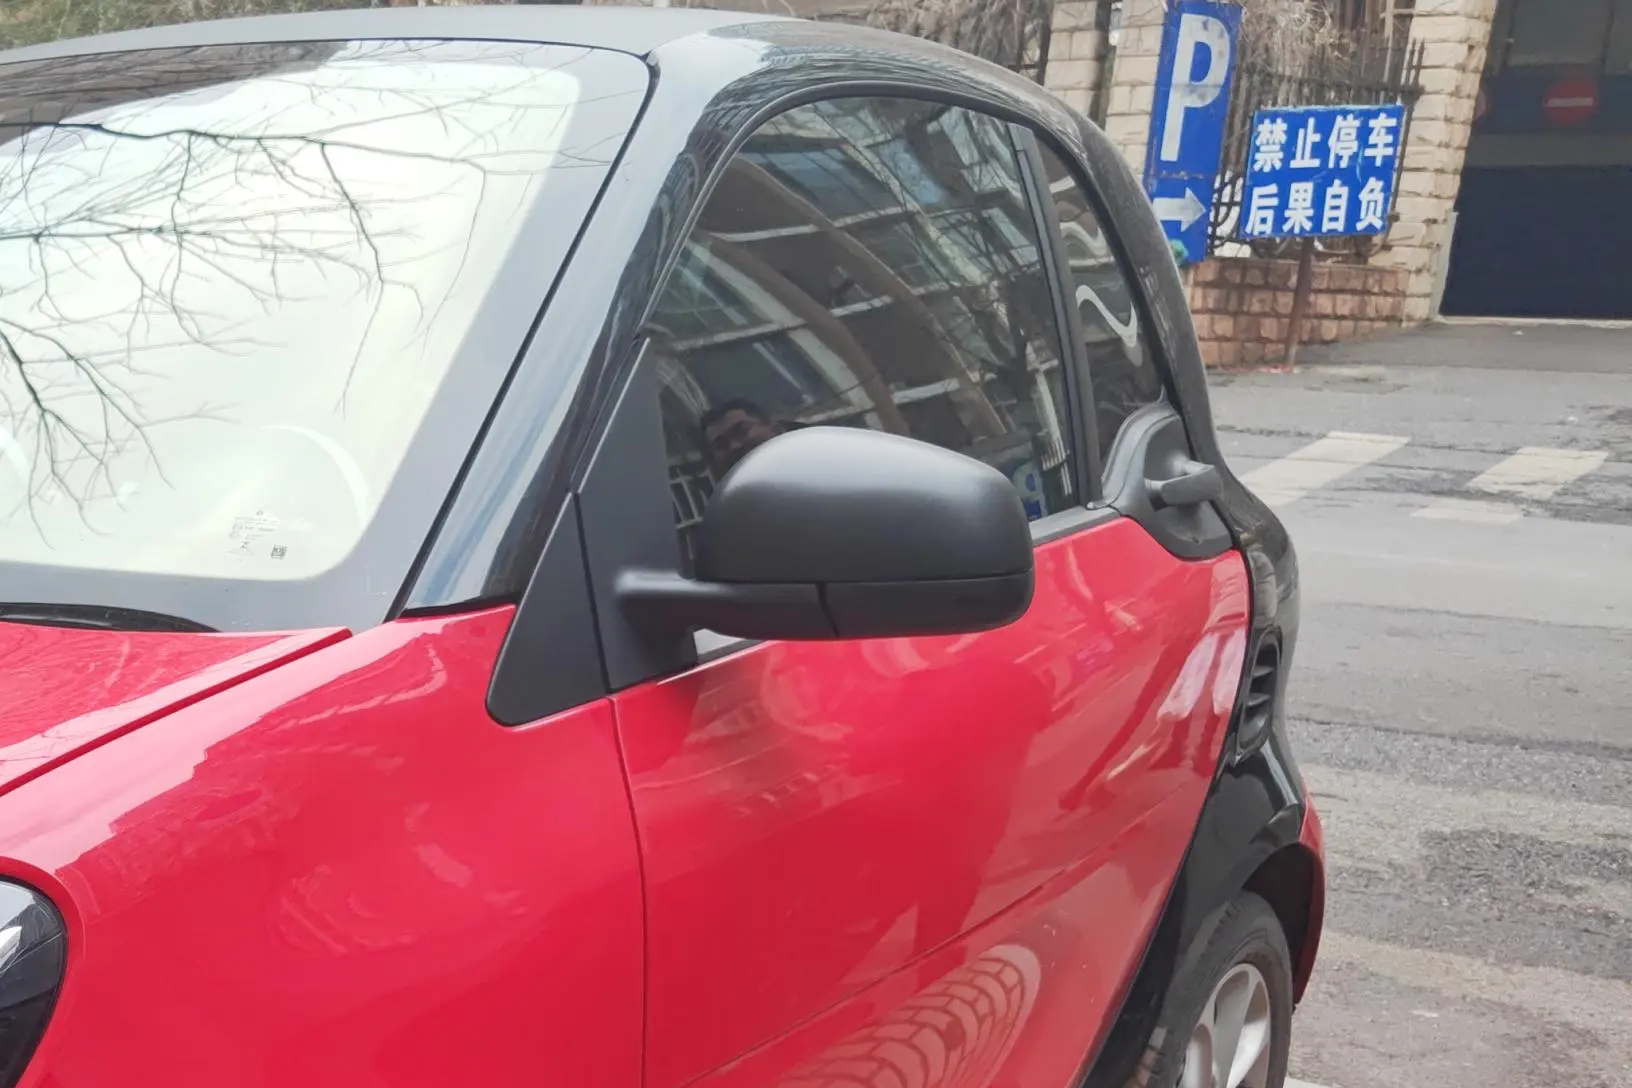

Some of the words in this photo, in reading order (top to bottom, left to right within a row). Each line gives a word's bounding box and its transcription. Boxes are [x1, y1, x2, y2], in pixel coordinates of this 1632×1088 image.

[1160, 13, 1230, 162] P
[1252, 111, 1398, 173] 禁止停车
[1245, 176, 1387, 236] 后果自负
